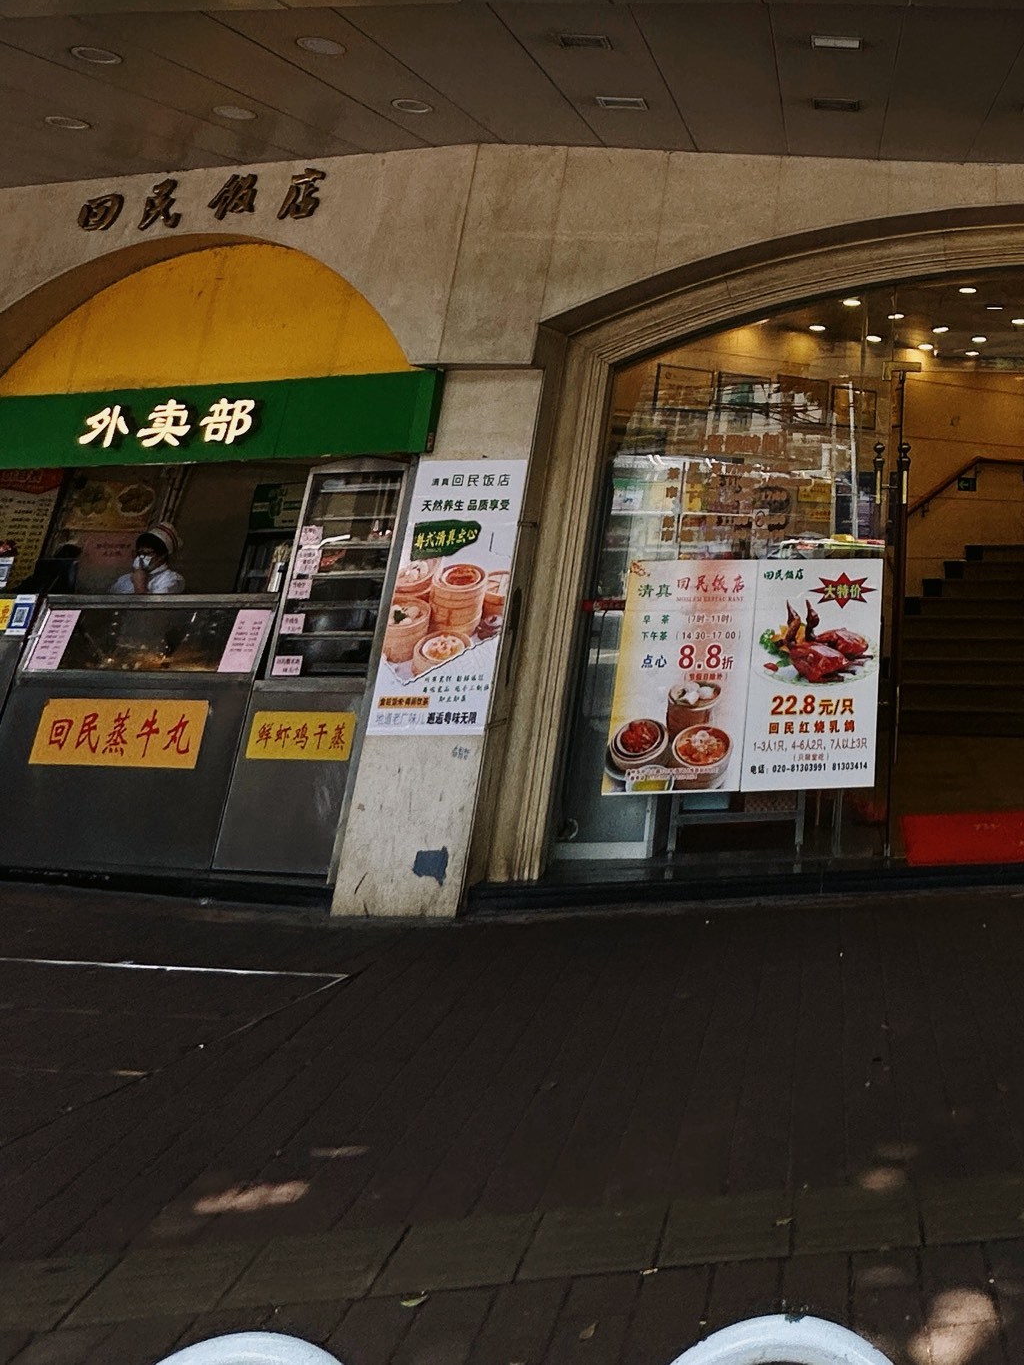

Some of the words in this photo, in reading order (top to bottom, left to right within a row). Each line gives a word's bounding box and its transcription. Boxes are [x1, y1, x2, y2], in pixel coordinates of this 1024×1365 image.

[78, 397, 256, 448] 外卖部
[421, 499, 465, 512] 天然养生
[467, 498, 510, 512] 品质享受
[637, 583, 672, 598] 清真
[676, 574, 745, 594] 回民饭店
[824, 583, 862, 599] 大特价
[641, 631, 668, 641] 下午茶
[641, 654, 667, 669] 点心
[678, 644, 734, 670] 8.8折
[770, 694, 854, 716] 22.8元/只
[48, 709, 192, 758] 回民蒸牛丸
[768, 719, 855, 735] 回民红烧乳鸽
[772, 762, 827, 774] 020-81303991
[831, 761, 868, 771] 81303414
